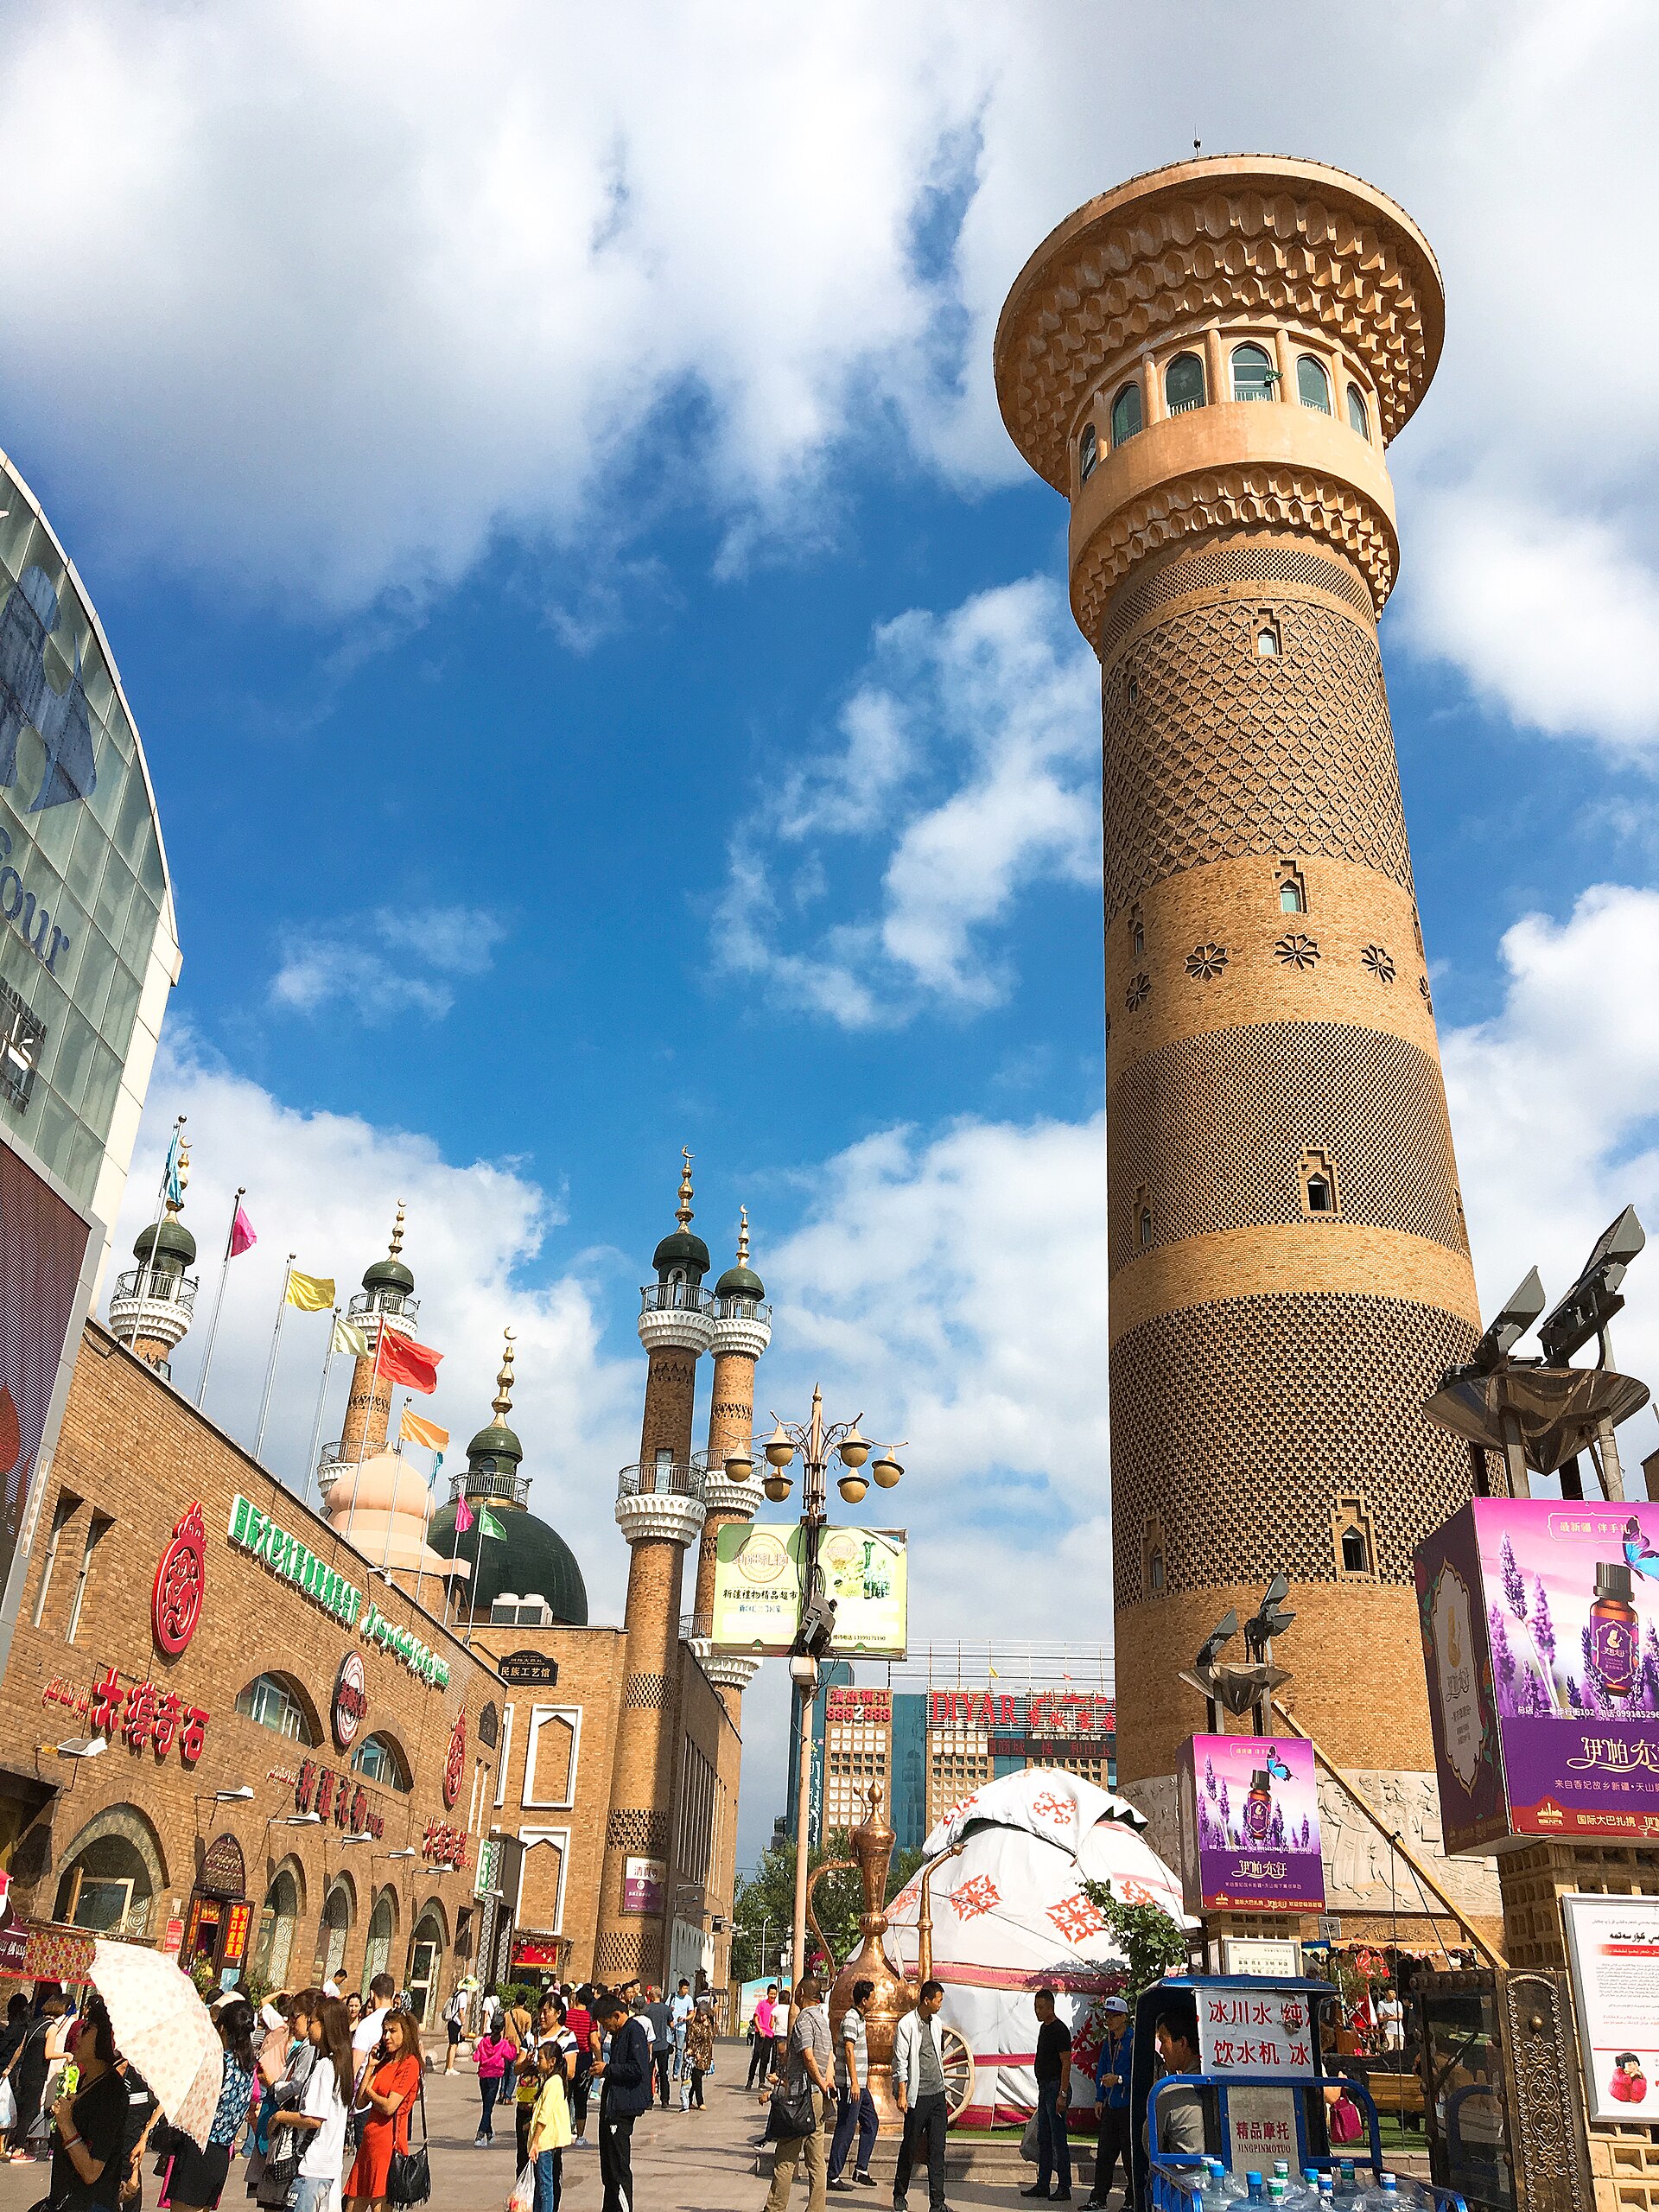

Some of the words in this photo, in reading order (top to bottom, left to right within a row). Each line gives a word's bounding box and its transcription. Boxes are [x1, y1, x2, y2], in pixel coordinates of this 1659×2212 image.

[501, 1666, 550, 1678] 民族工艺馆
[830, 1690, 889, 1705] 演出预订
[931, 1693, 1018, 1725] DIYAR
[91, 1667, 210, 1762] 大漠奇石
[826, 1705, 891, 1722] 8882888
[1567, 1736, 1659, 1773] 伊帕尔
[1208, 1999, 1273, 2025] 冰川水
[1280, 2001, 1310, 2026] 纯
[1213, 2039, 1280, 2065] 饮水机
[1288, 2042, 1311, 2066] 冰
[1236, 2120, 1290, 2141] 精品摩托
[1236, 2143, 1291, 2154] JINGPINMOTUO
